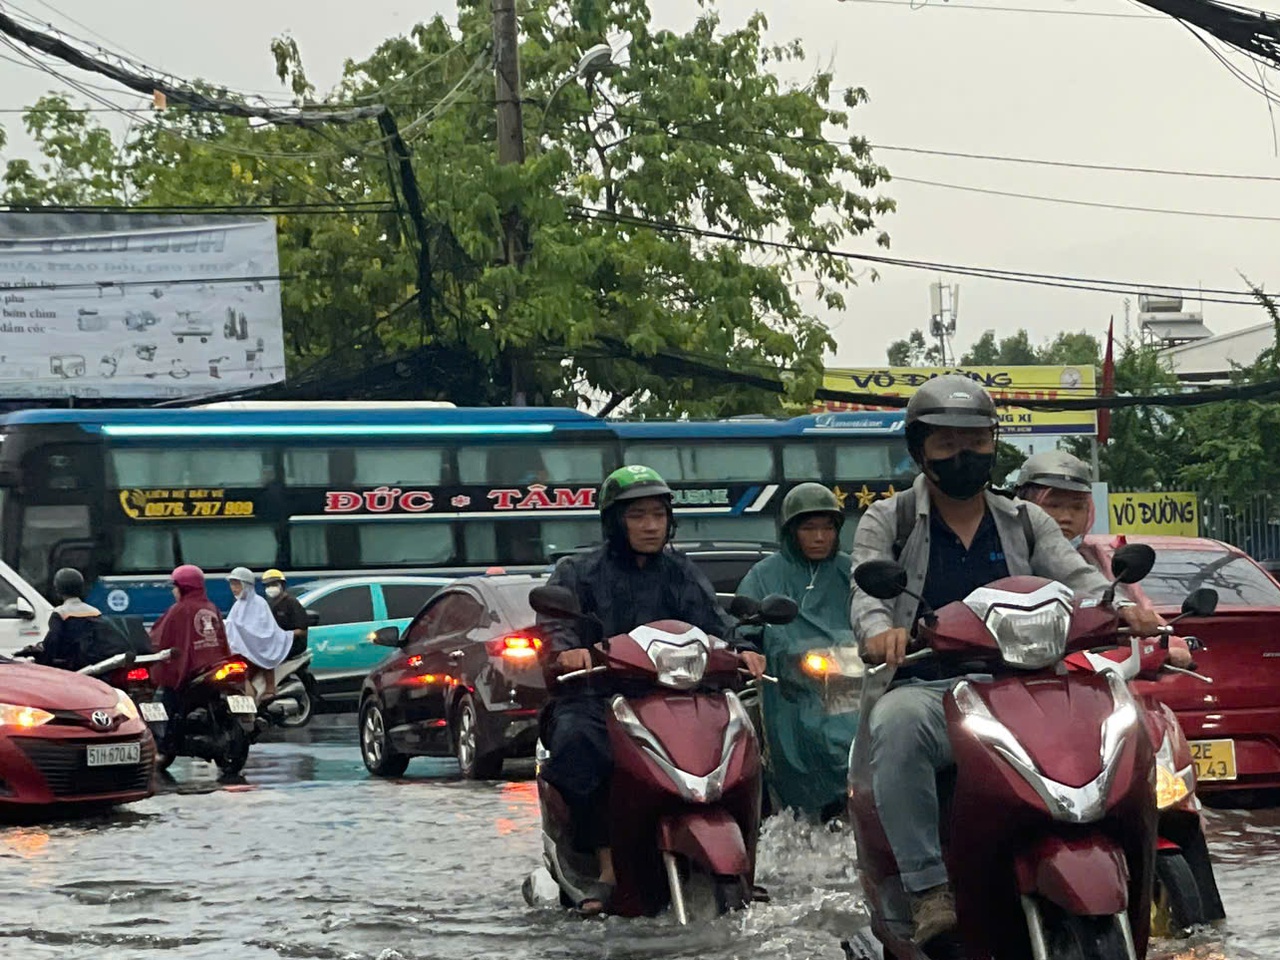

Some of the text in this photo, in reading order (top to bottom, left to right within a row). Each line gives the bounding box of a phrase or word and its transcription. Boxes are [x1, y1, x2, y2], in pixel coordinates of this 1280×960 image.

[851, 368, 1013, 389] VÕ ĐNG
[324, 483, 597, 513] ĐỨC TÂM
[1113, 495, 1195, 526] VÕ ĐƯỜNG
[1192, 743, 1213, 761] 2E
